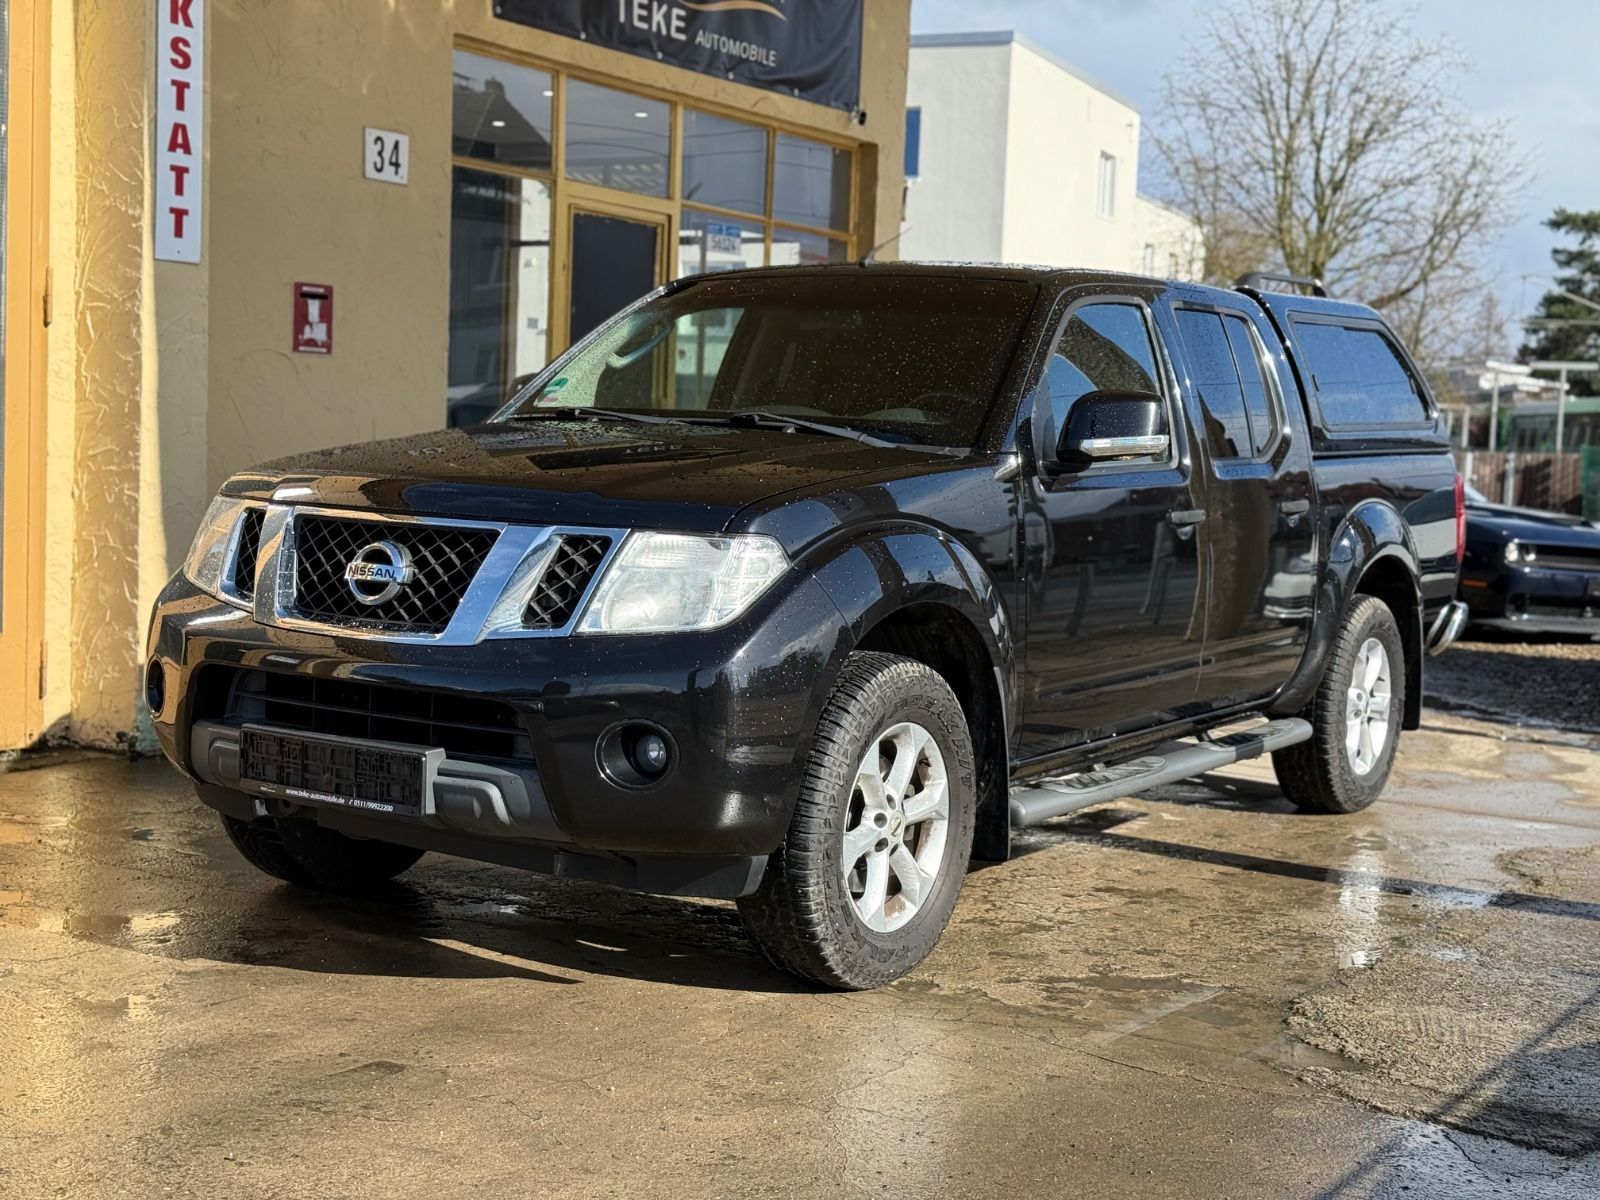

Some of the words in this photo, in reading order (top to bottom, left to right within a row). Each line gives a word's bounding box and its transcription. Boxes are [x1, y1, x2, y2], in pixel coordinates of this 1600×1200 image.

[695, 29, 777, 67] AUTOMOBILE
[373, 136, 401, 176] 34
[348, 564, 396, 579] NISSAN
[285, 788, 345, 805] www.teke-automobile.de
[353, 799, 394, 812] 0511/99922200
